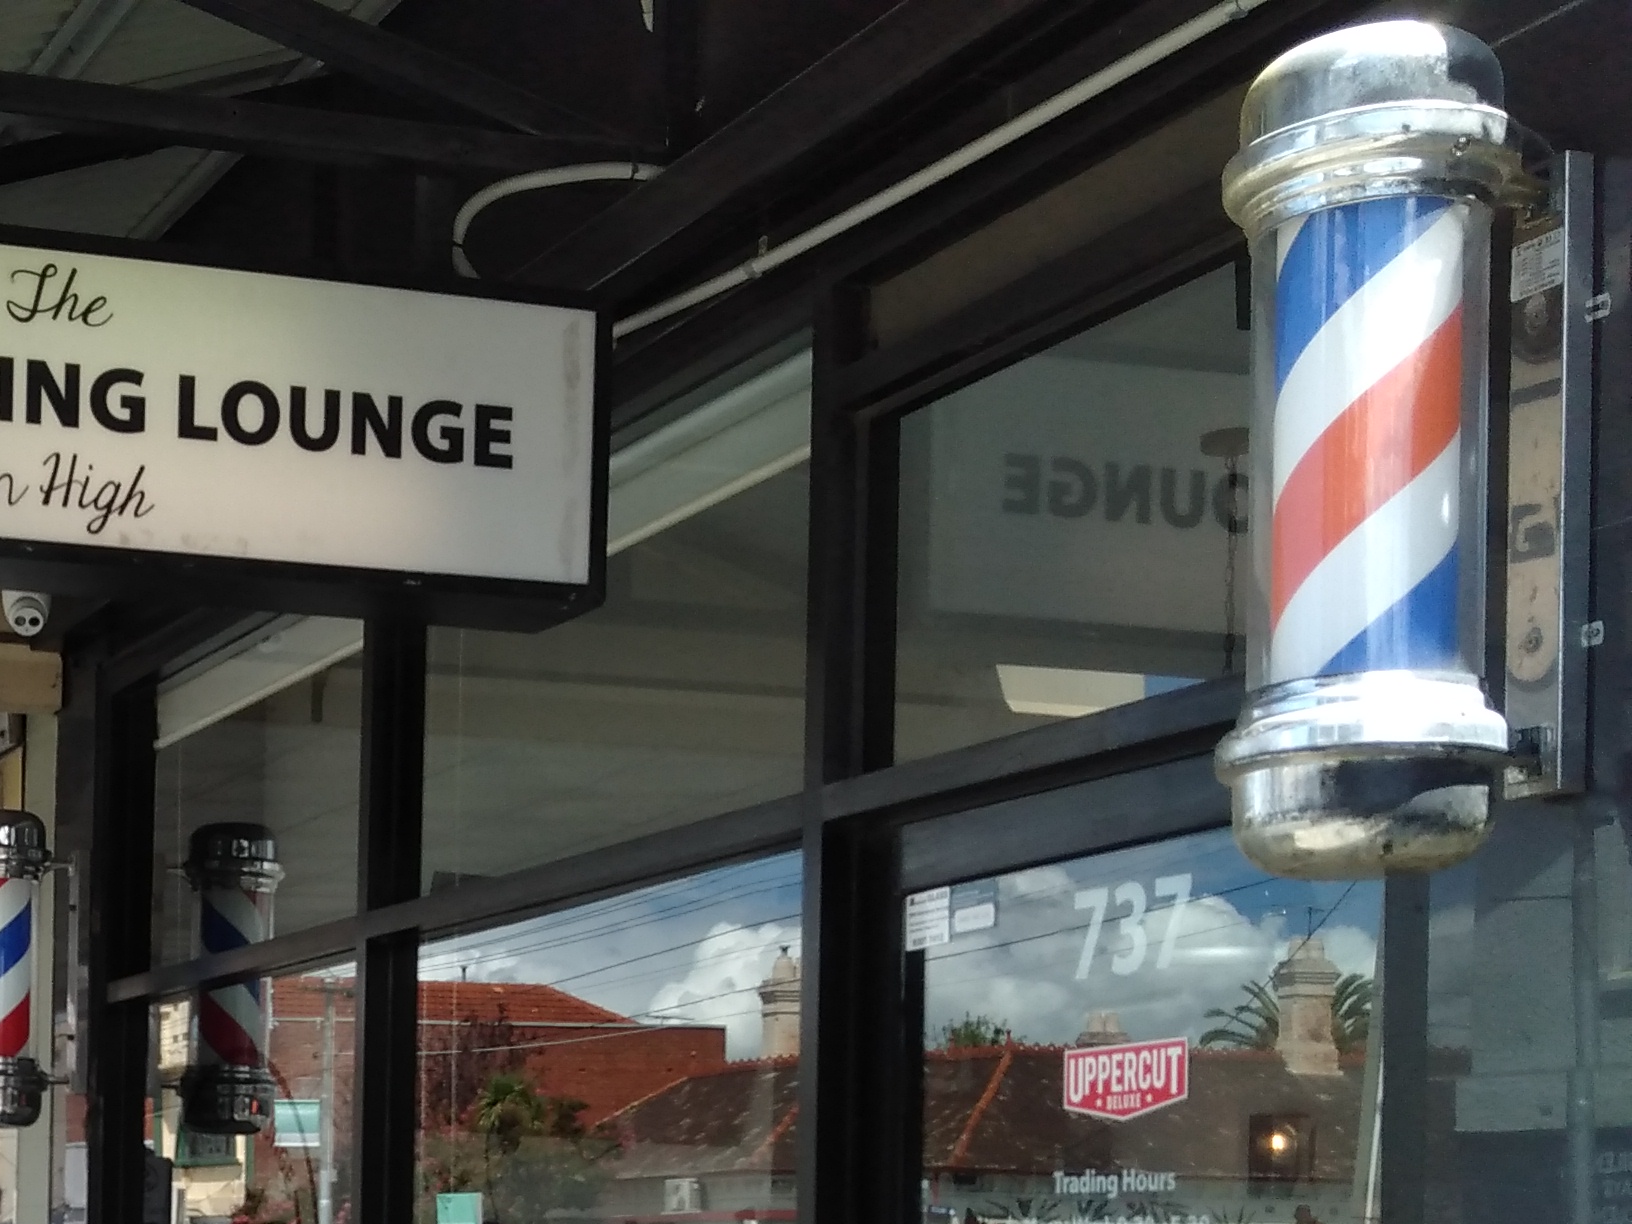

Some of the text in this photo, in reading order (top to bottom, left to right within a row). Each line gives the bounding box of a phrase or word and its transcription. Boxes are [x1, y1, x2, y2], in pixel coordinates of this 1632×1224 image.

[7, 263, 113, 327] The
[177, 374, 515, 469] LOUNGE
[40, 452, 155, 535] High
[1074, 873, 1192, 979] 737
[1069, 1046, 1182, 1103] UPPERCUT
[1106, 1092, 1141, 1110] DELUXE
[1053, 1169, 1176, 1198] Trading Hours
